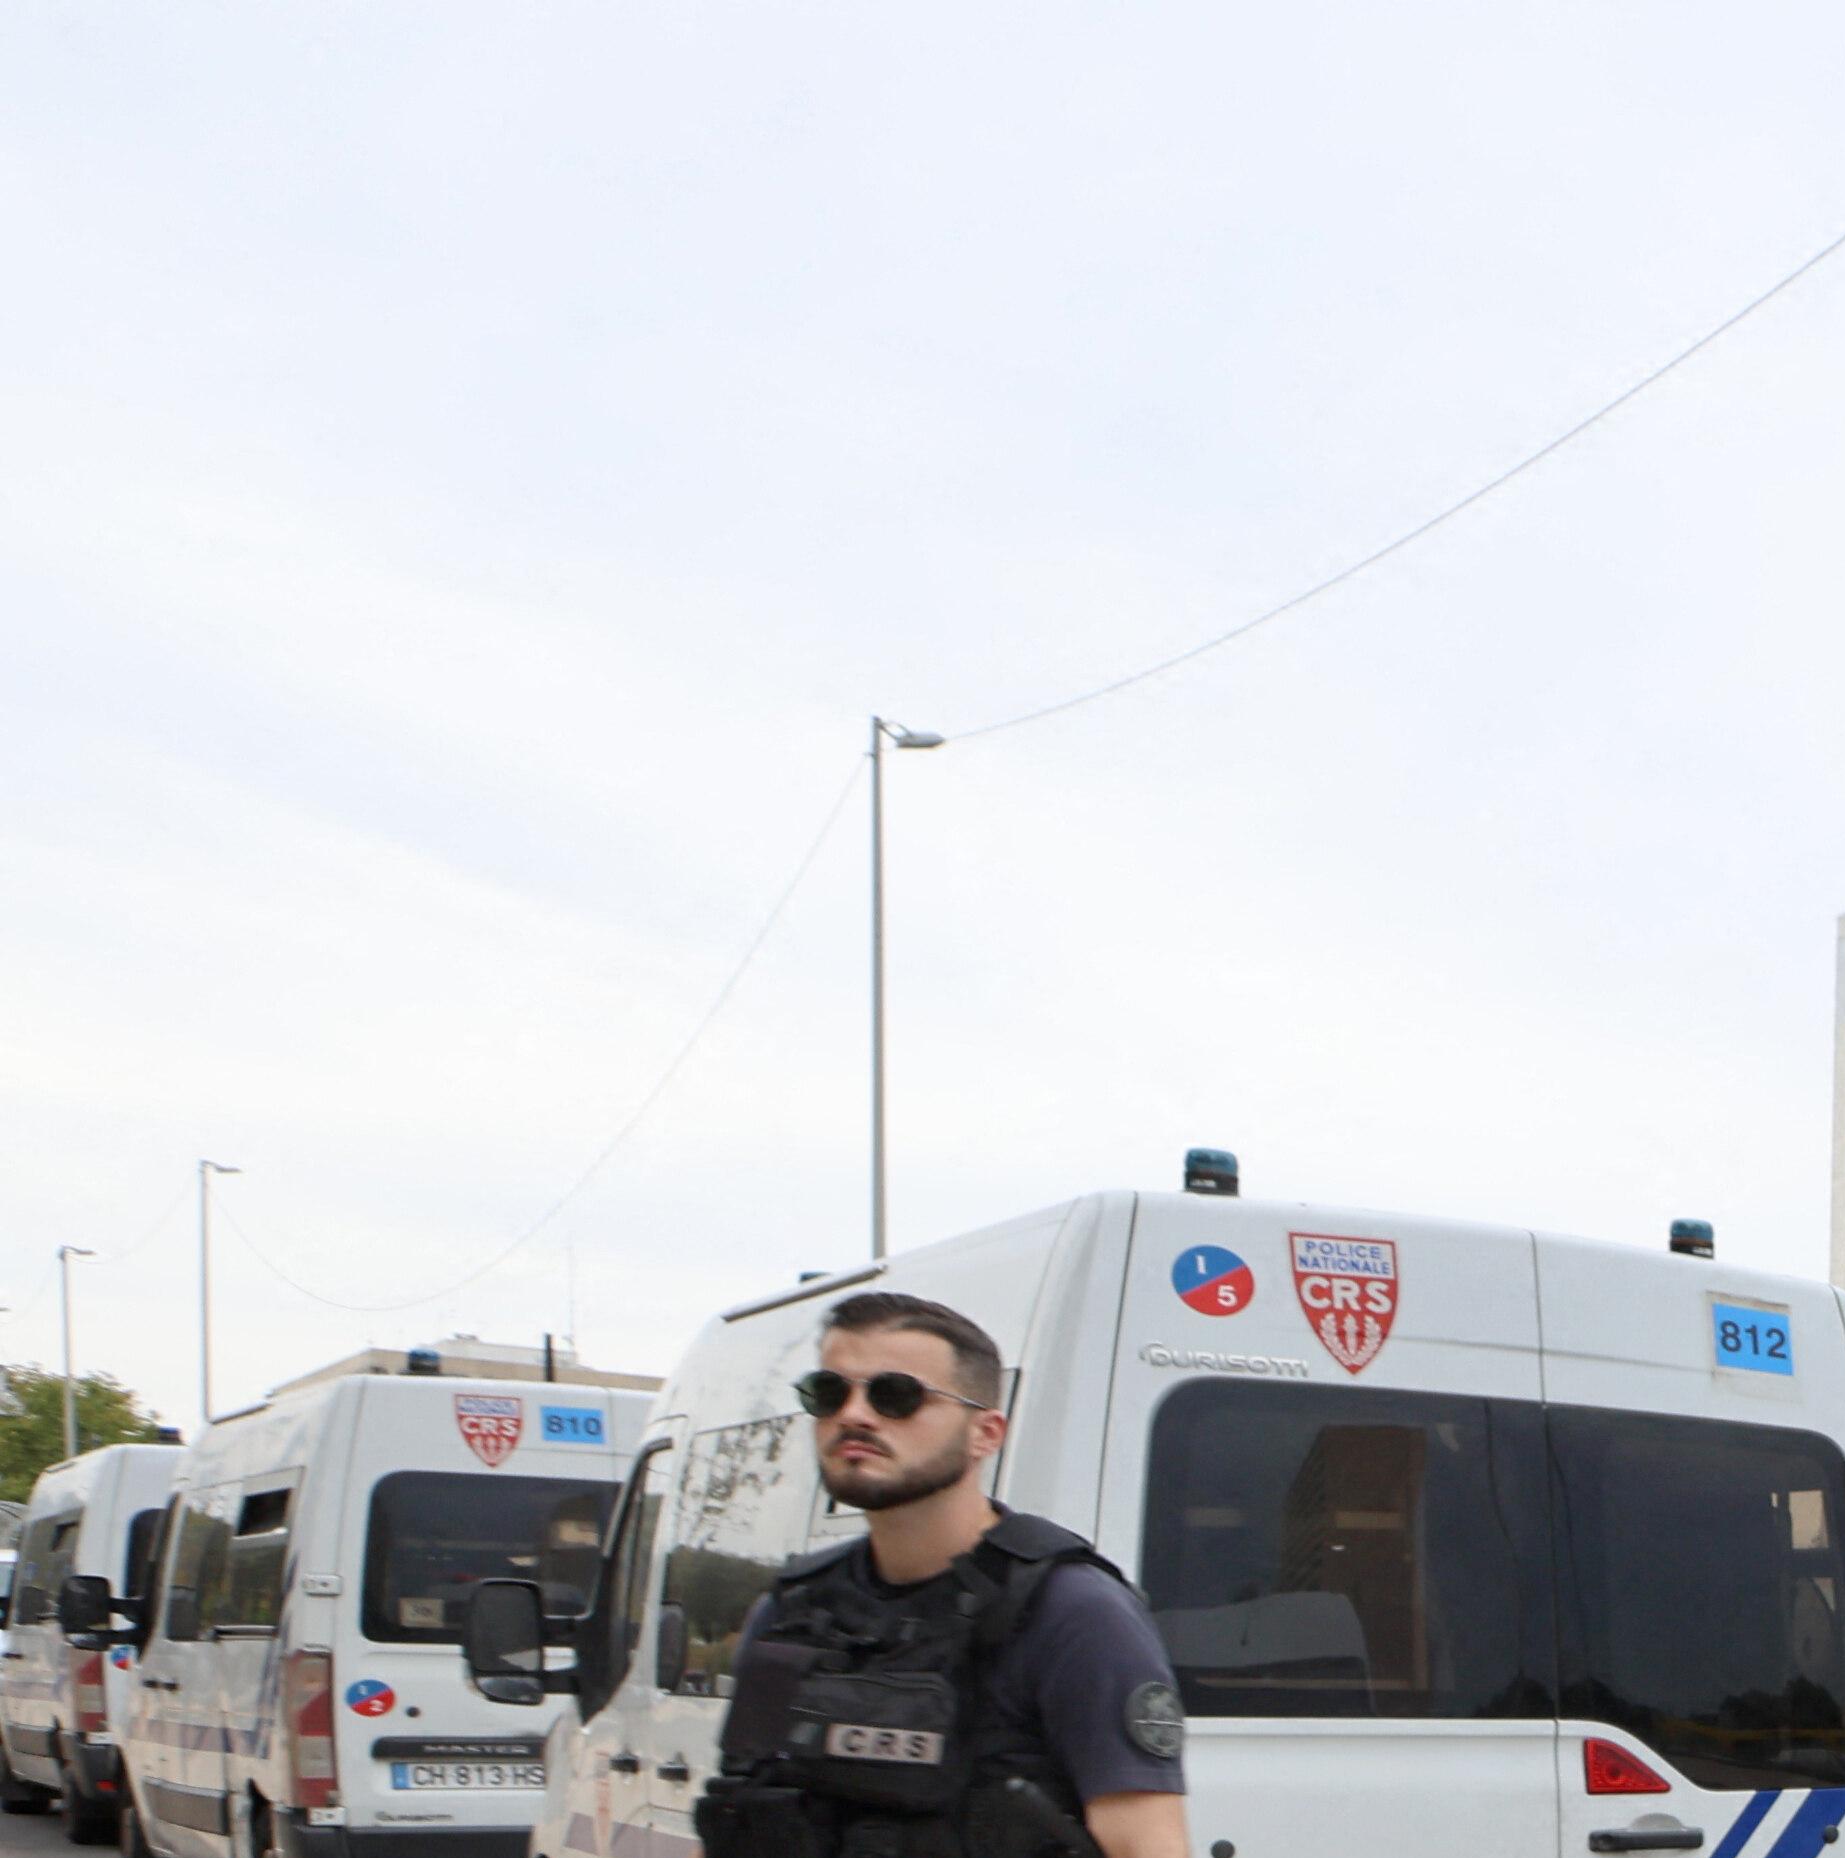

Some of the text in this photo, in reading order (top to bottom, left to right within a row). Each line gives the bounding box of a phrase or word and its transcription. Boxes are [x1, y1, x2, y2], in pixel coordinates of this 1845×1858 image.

[1305, 1240, 1382, 1259] POLICE
[1298, 1256, 1390, 1275] NATIONALE
[1217, 1285, 1238, 1307] 5
[1301, 1275, 1393, 1315] CRS
[1720, 1320, 1787, 1359] 812
[461, 1416, 519, 1438] CRS
[546, 1415, 601, 1436] 810
[842, 1728, 927, 1758] CRS
